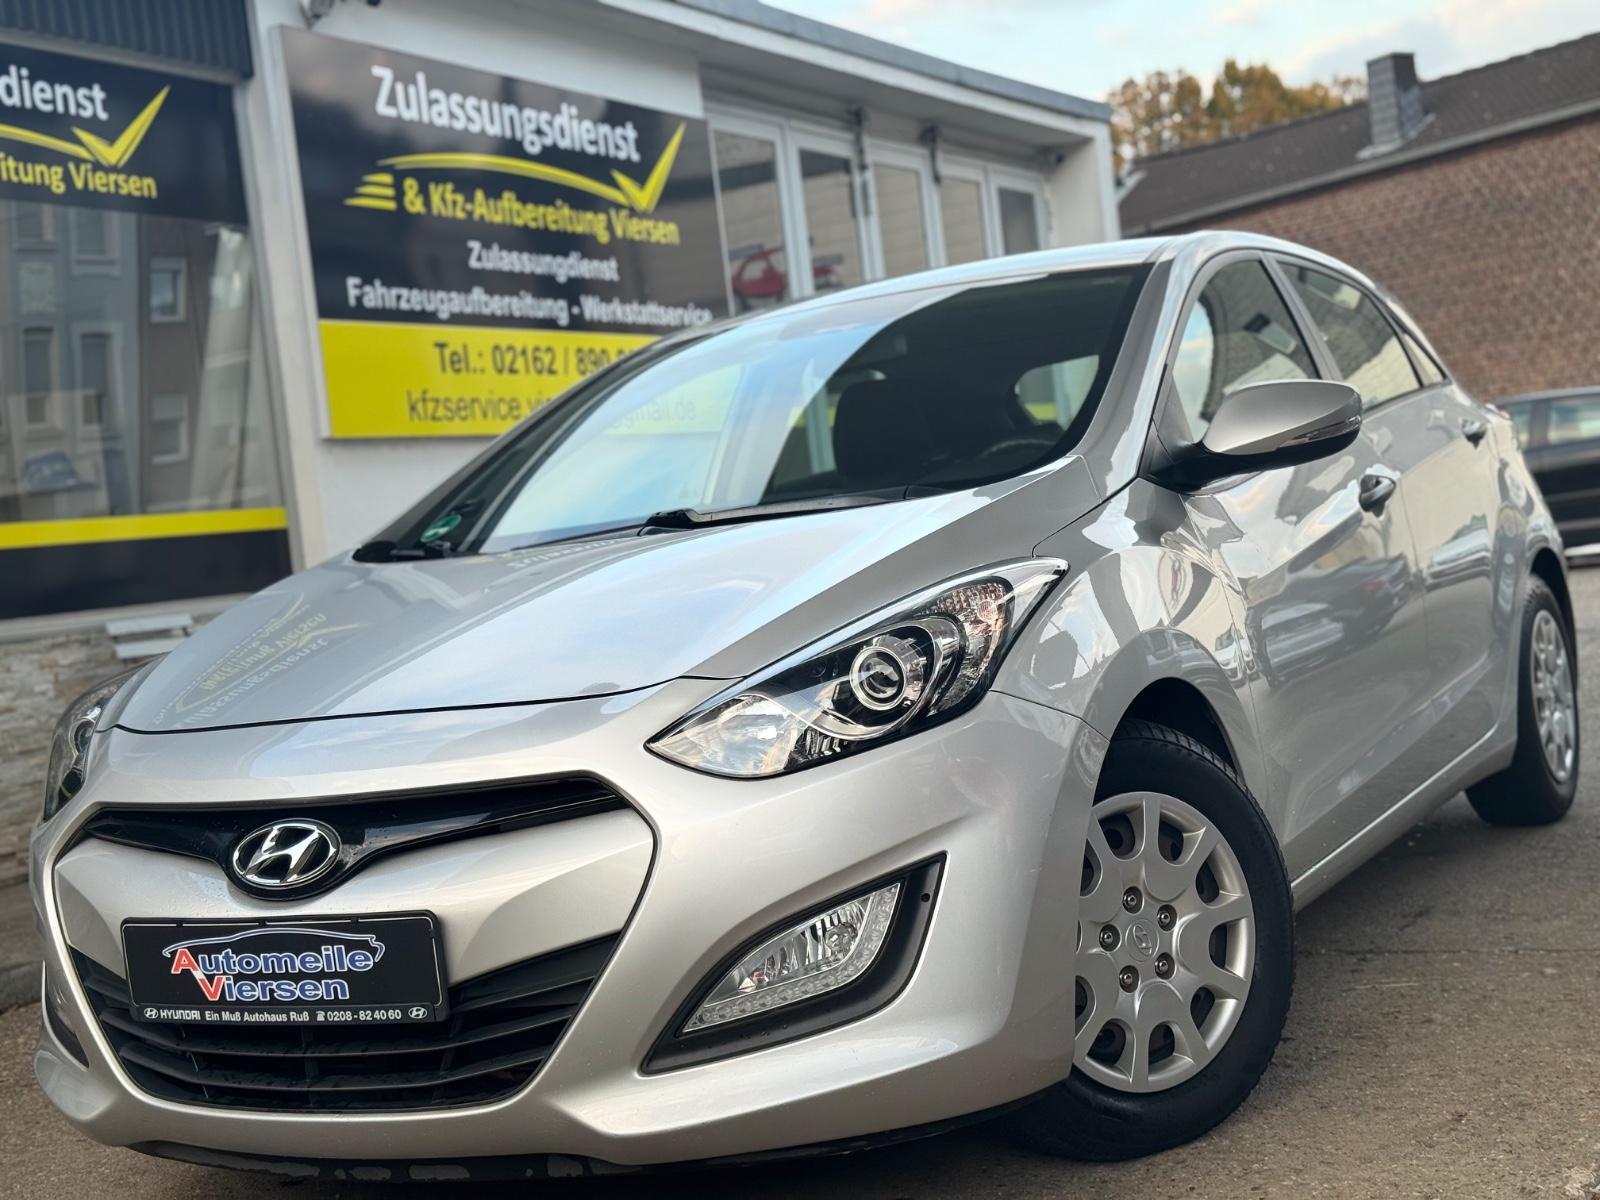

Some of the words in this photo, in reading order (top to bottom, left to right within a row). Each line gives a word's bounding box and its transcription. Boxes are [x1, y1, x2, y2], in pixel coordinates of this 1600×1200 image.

[0, 64, 109, 121] dienst
[371, 65, 641, 162] Zulassungsdienst
[67, 161, 158, 199] Viersen
[402, 176, 425, 214] &
[428, 182, 609, 244] Kfz-Aufbereitung
[609, 208, 680, 245] Viersen
[467, 239, 620, 283] Zulassungdienst
[346, 275, 570, 328] Fahrzeugaufbereitung
[579, 293, 713, 327] Werkstattservice
[433, 342, 485, 375] Tel.:
[491, 345, 557, 376] 02162
[171, 944, 374, 974] Automeile
[199, 973, 350, 1001] Viersen
[160, 1009, 201, 1020] HYUNDAI
[205, 1010, 220, 1021] Ein
[222, 1011, 242, 1022] Muß
[243, 1011, 288, 1022] Autohaus
[290, 1011, 310, 1022] Ruß
[327, 1010, 352, 1021] 0208
